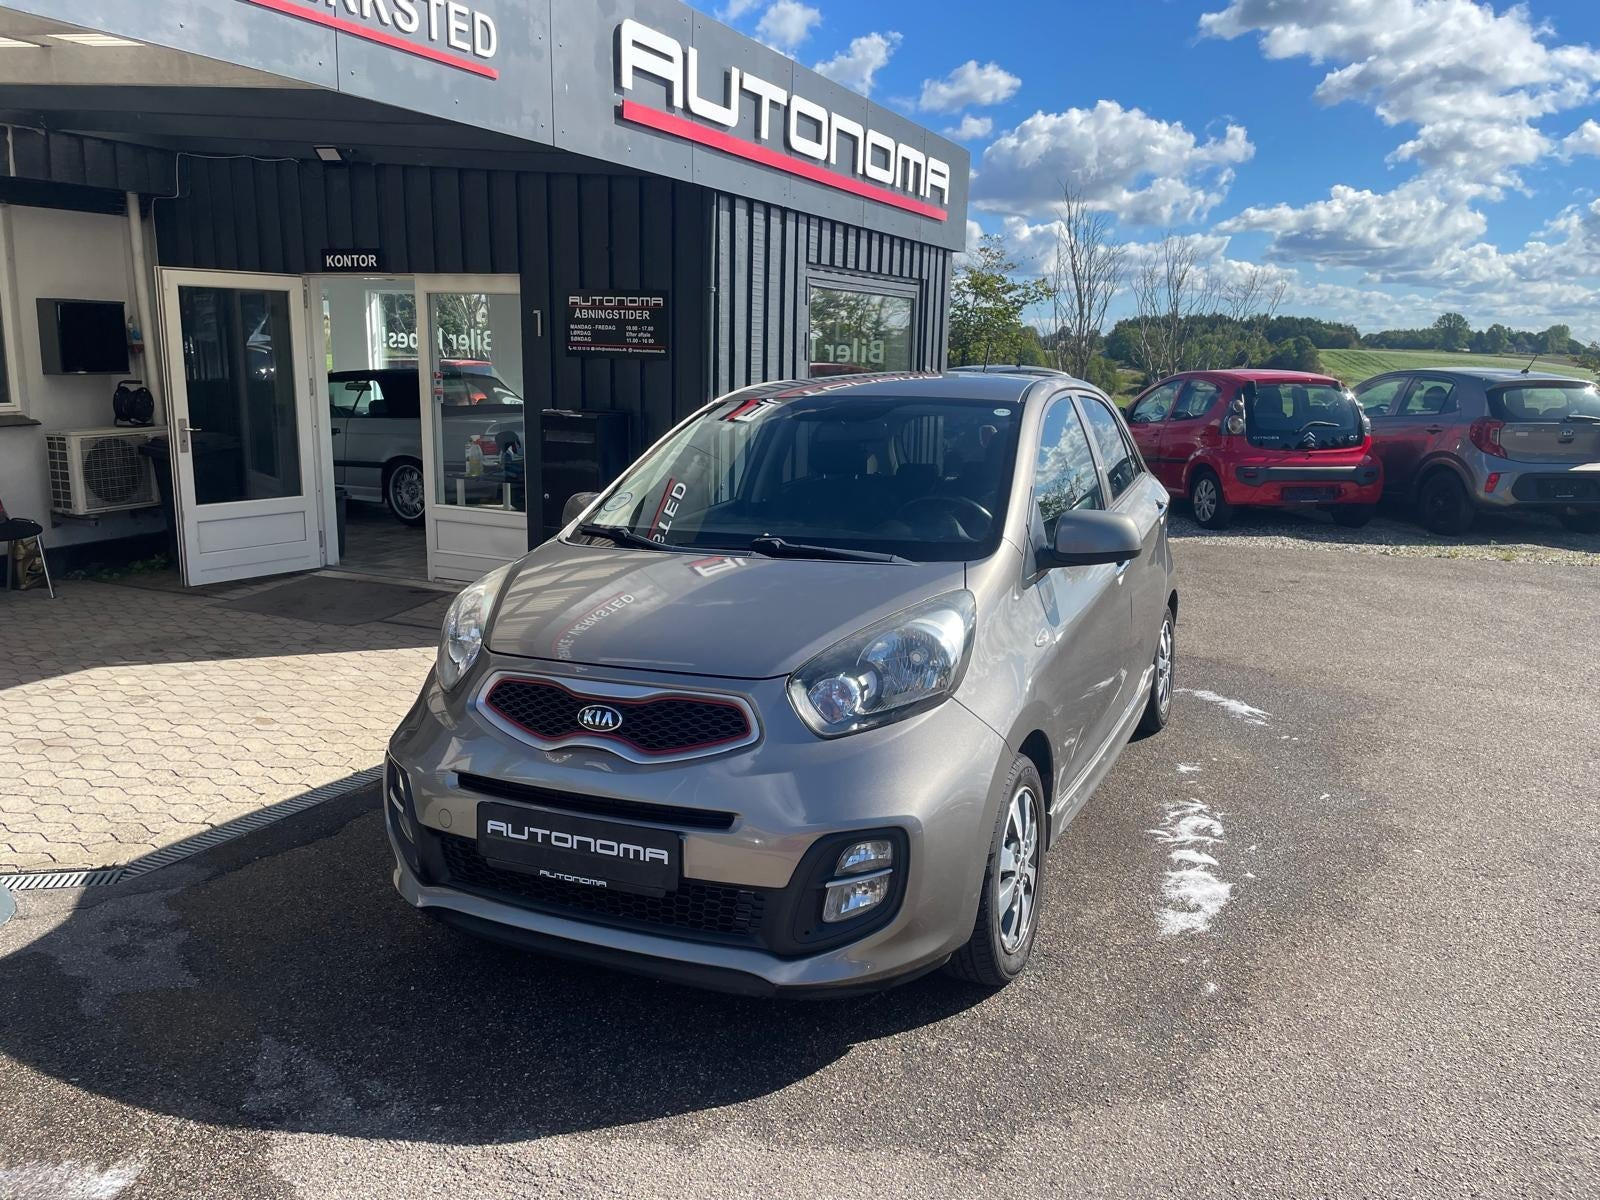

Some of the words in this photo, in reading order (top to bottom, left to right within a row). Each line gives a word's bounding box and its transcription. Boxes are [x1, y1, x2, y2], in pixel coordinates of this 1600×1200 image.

[621, 18, 950, 205] AUTONOMA
[326, 255, 377, 267] KONTOR
[568, 296, 664, 306] AUTONOMA
[574, 308, 650, 320] ÅBNINGSTIDER
[582, 708, 614, 728] KIA
[487, 820, 669, 865] AUTONOMA
[540, 869, 607, 888] AUTONOMA
